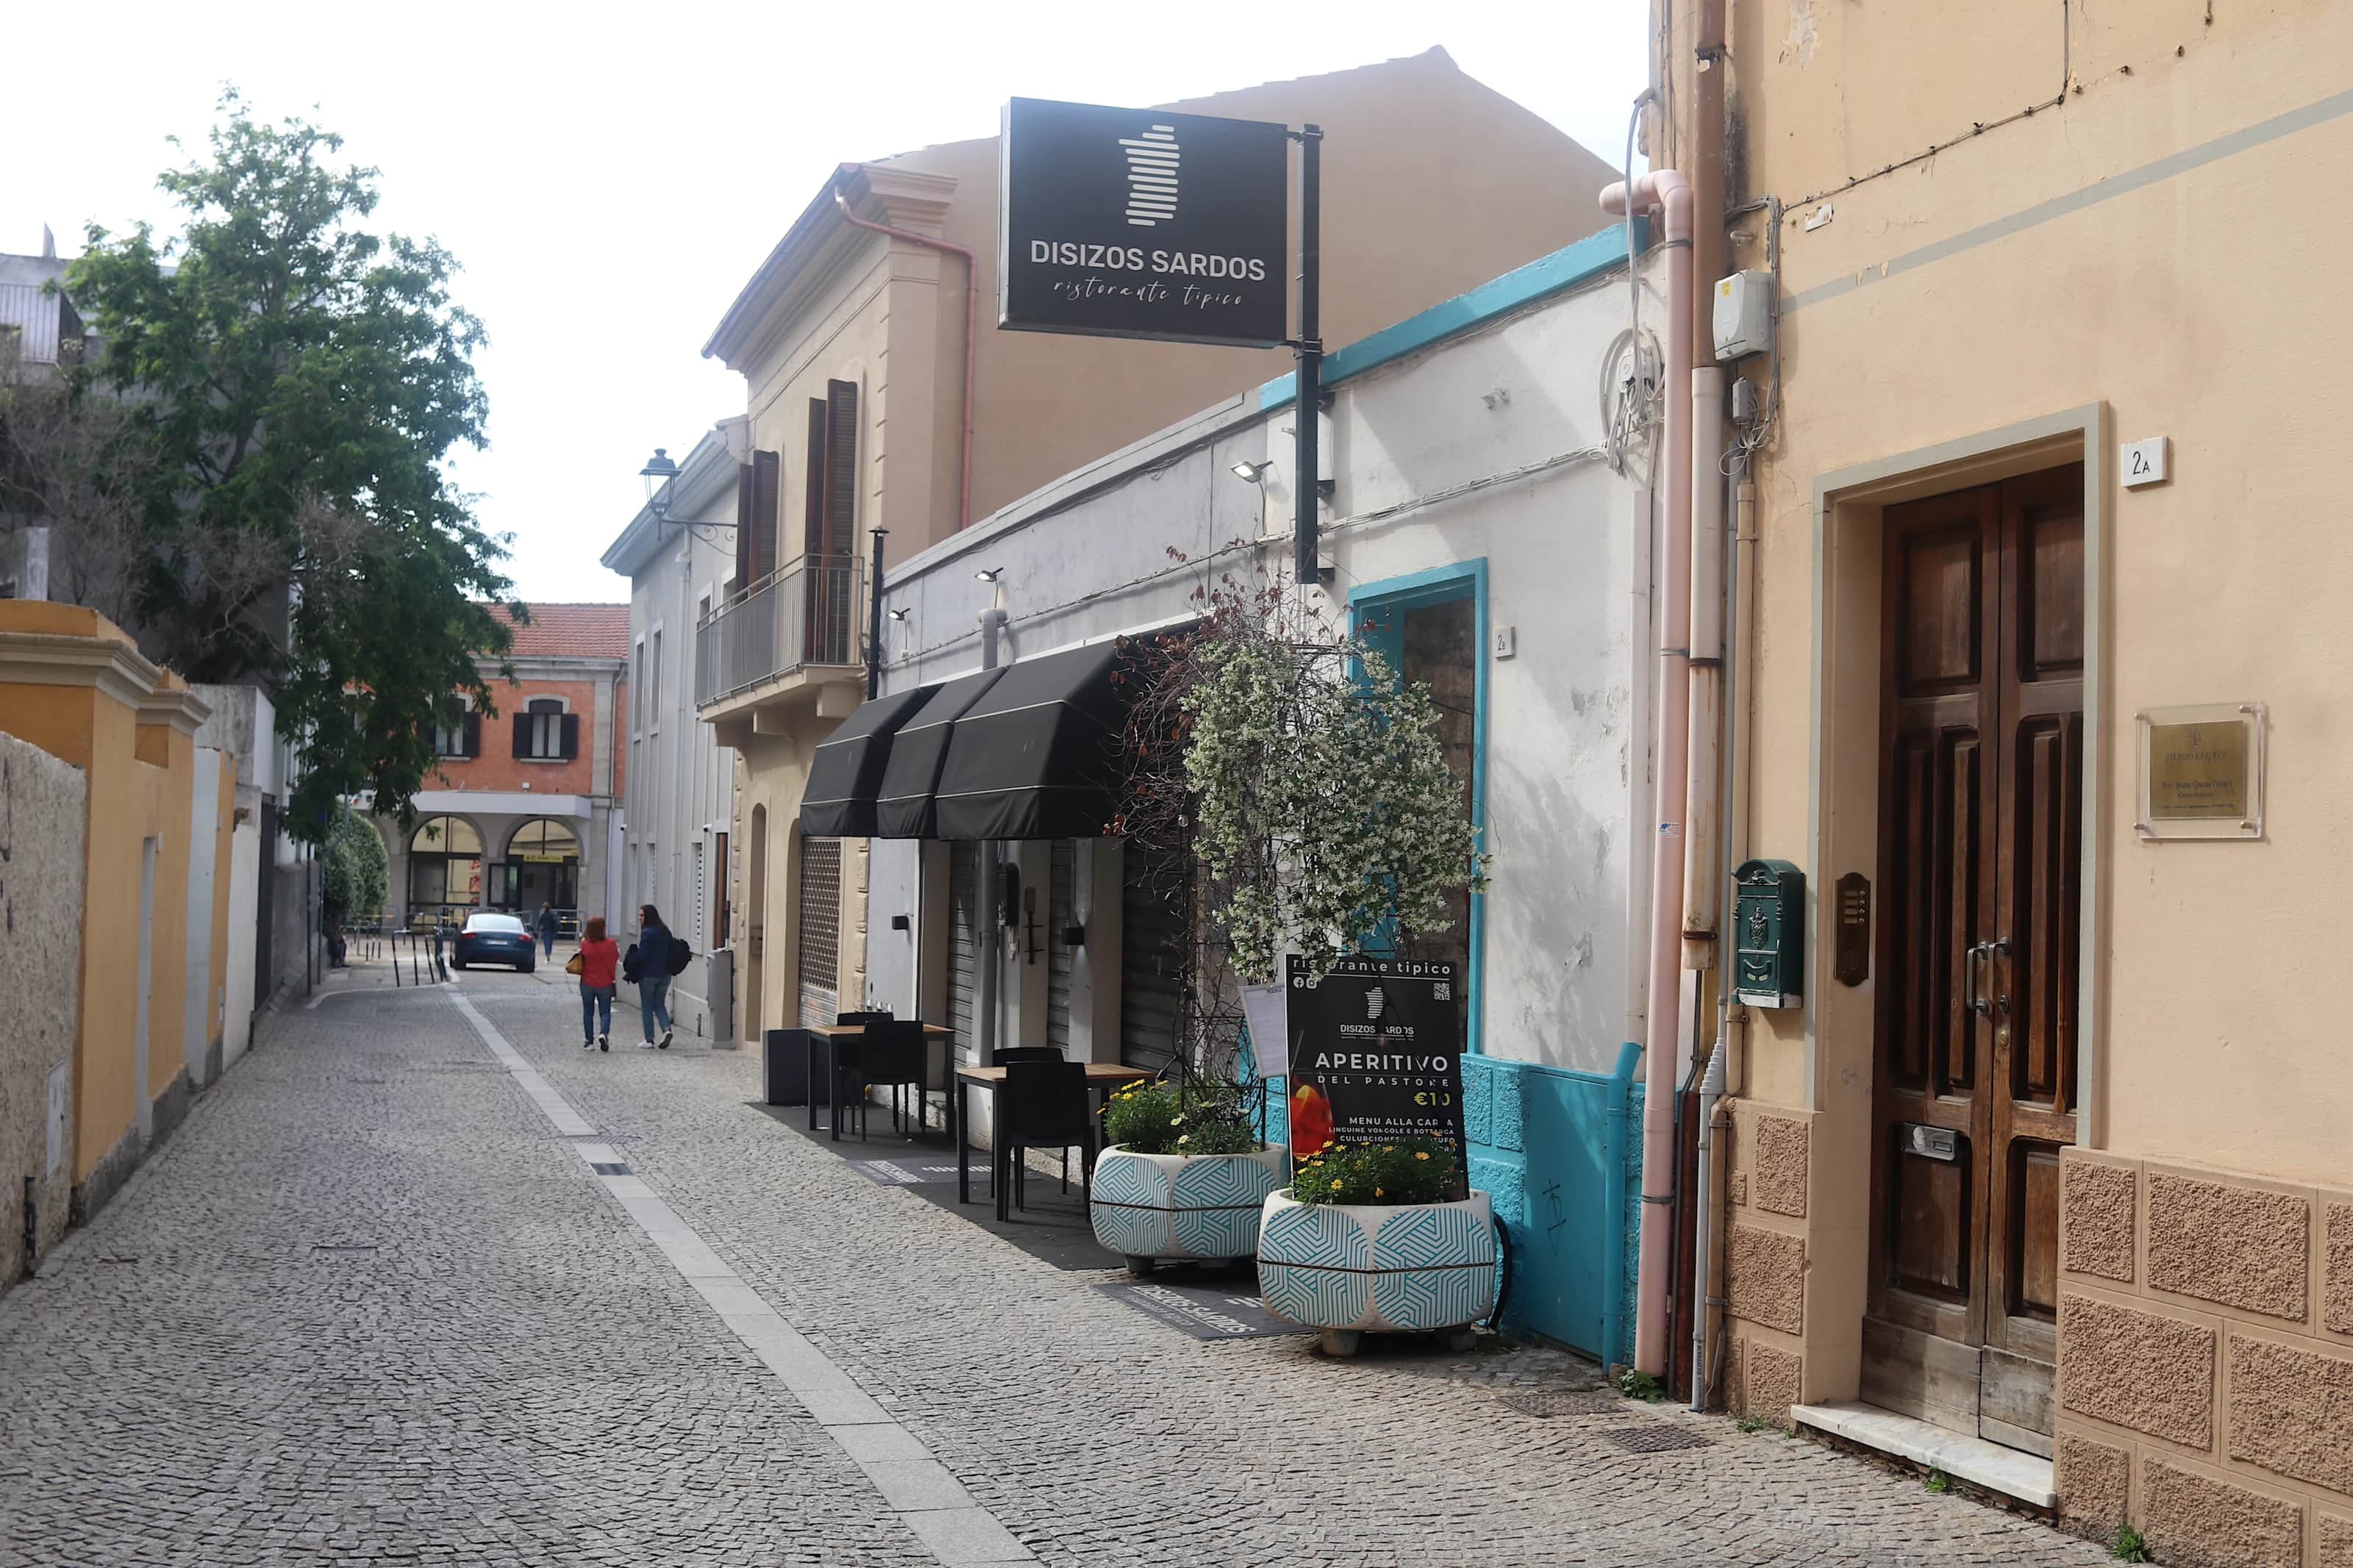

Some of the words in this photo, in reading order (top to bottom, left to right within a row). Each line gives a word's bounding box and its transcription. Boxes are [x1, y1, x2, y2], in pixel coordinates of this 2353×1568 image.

[1031, 240, 1144, 271] DISIZOS
[1151, 250, 1265, 281] SARDOS
[1054, 276, 1170, 302] ristorante
[1183, 284, 1242, 309] tipico
[2132, 451, 2151, 474] 2A
[1293, 959, 1388, 972] risorante
[1397, 962, 1451, 975] tipico
[1340, 1024, 1376, 1034] DISIZOS
[1315, 1052, 1448, 1072] APERITIVO
[1318, 1075, 1351, 1084] DEL
[1349, 1117, 1381, 1125] MENU
[1385, 1118, 1413, 1126] ALLA
[1417, 1118, 1454, 1127] CARA
